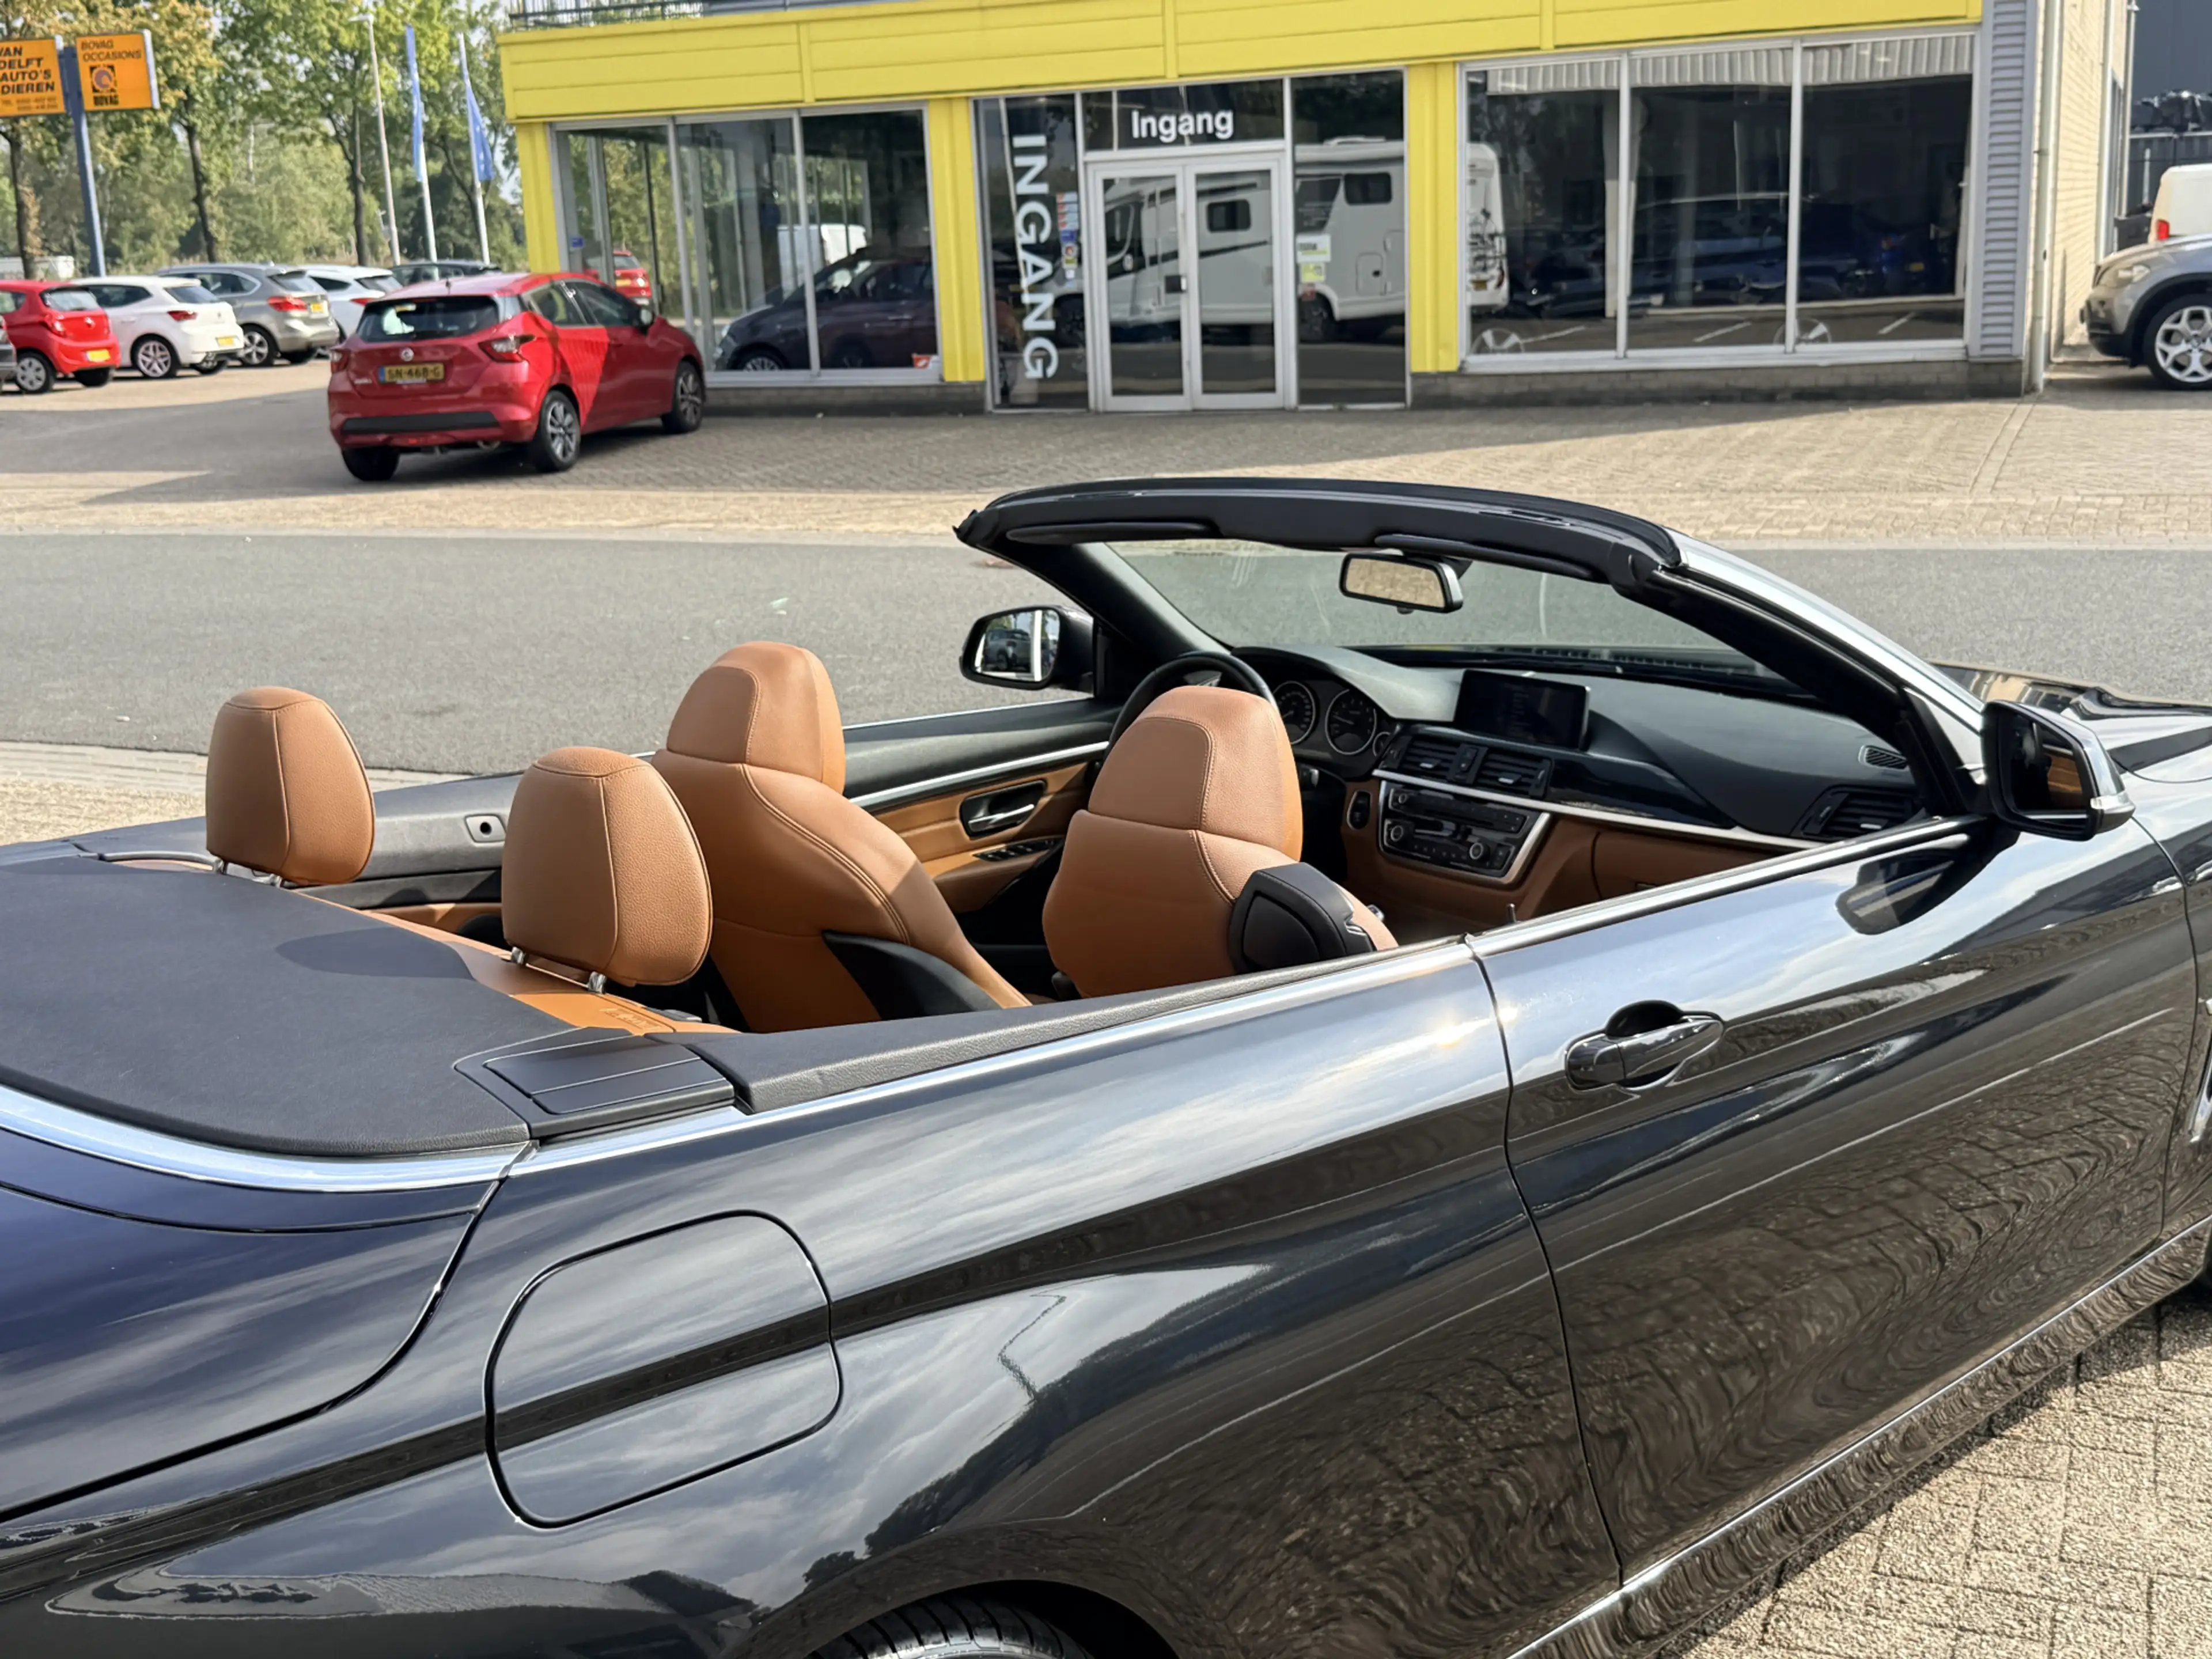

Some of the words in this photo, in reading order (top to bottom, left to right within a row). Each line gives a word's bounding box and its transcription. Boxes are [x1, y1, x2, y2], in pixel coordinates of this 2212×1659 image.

[83, 50, 142, 62] OCCASIONS
[0, 57, 44, 69] DELFT
[1, 69, 51, 81] AUTO'S
[2, 81, 55, 94] DIEREN
[1131, 109, 1234, 143] Ingang
[1013, 134, 1059, 379] INGANG
